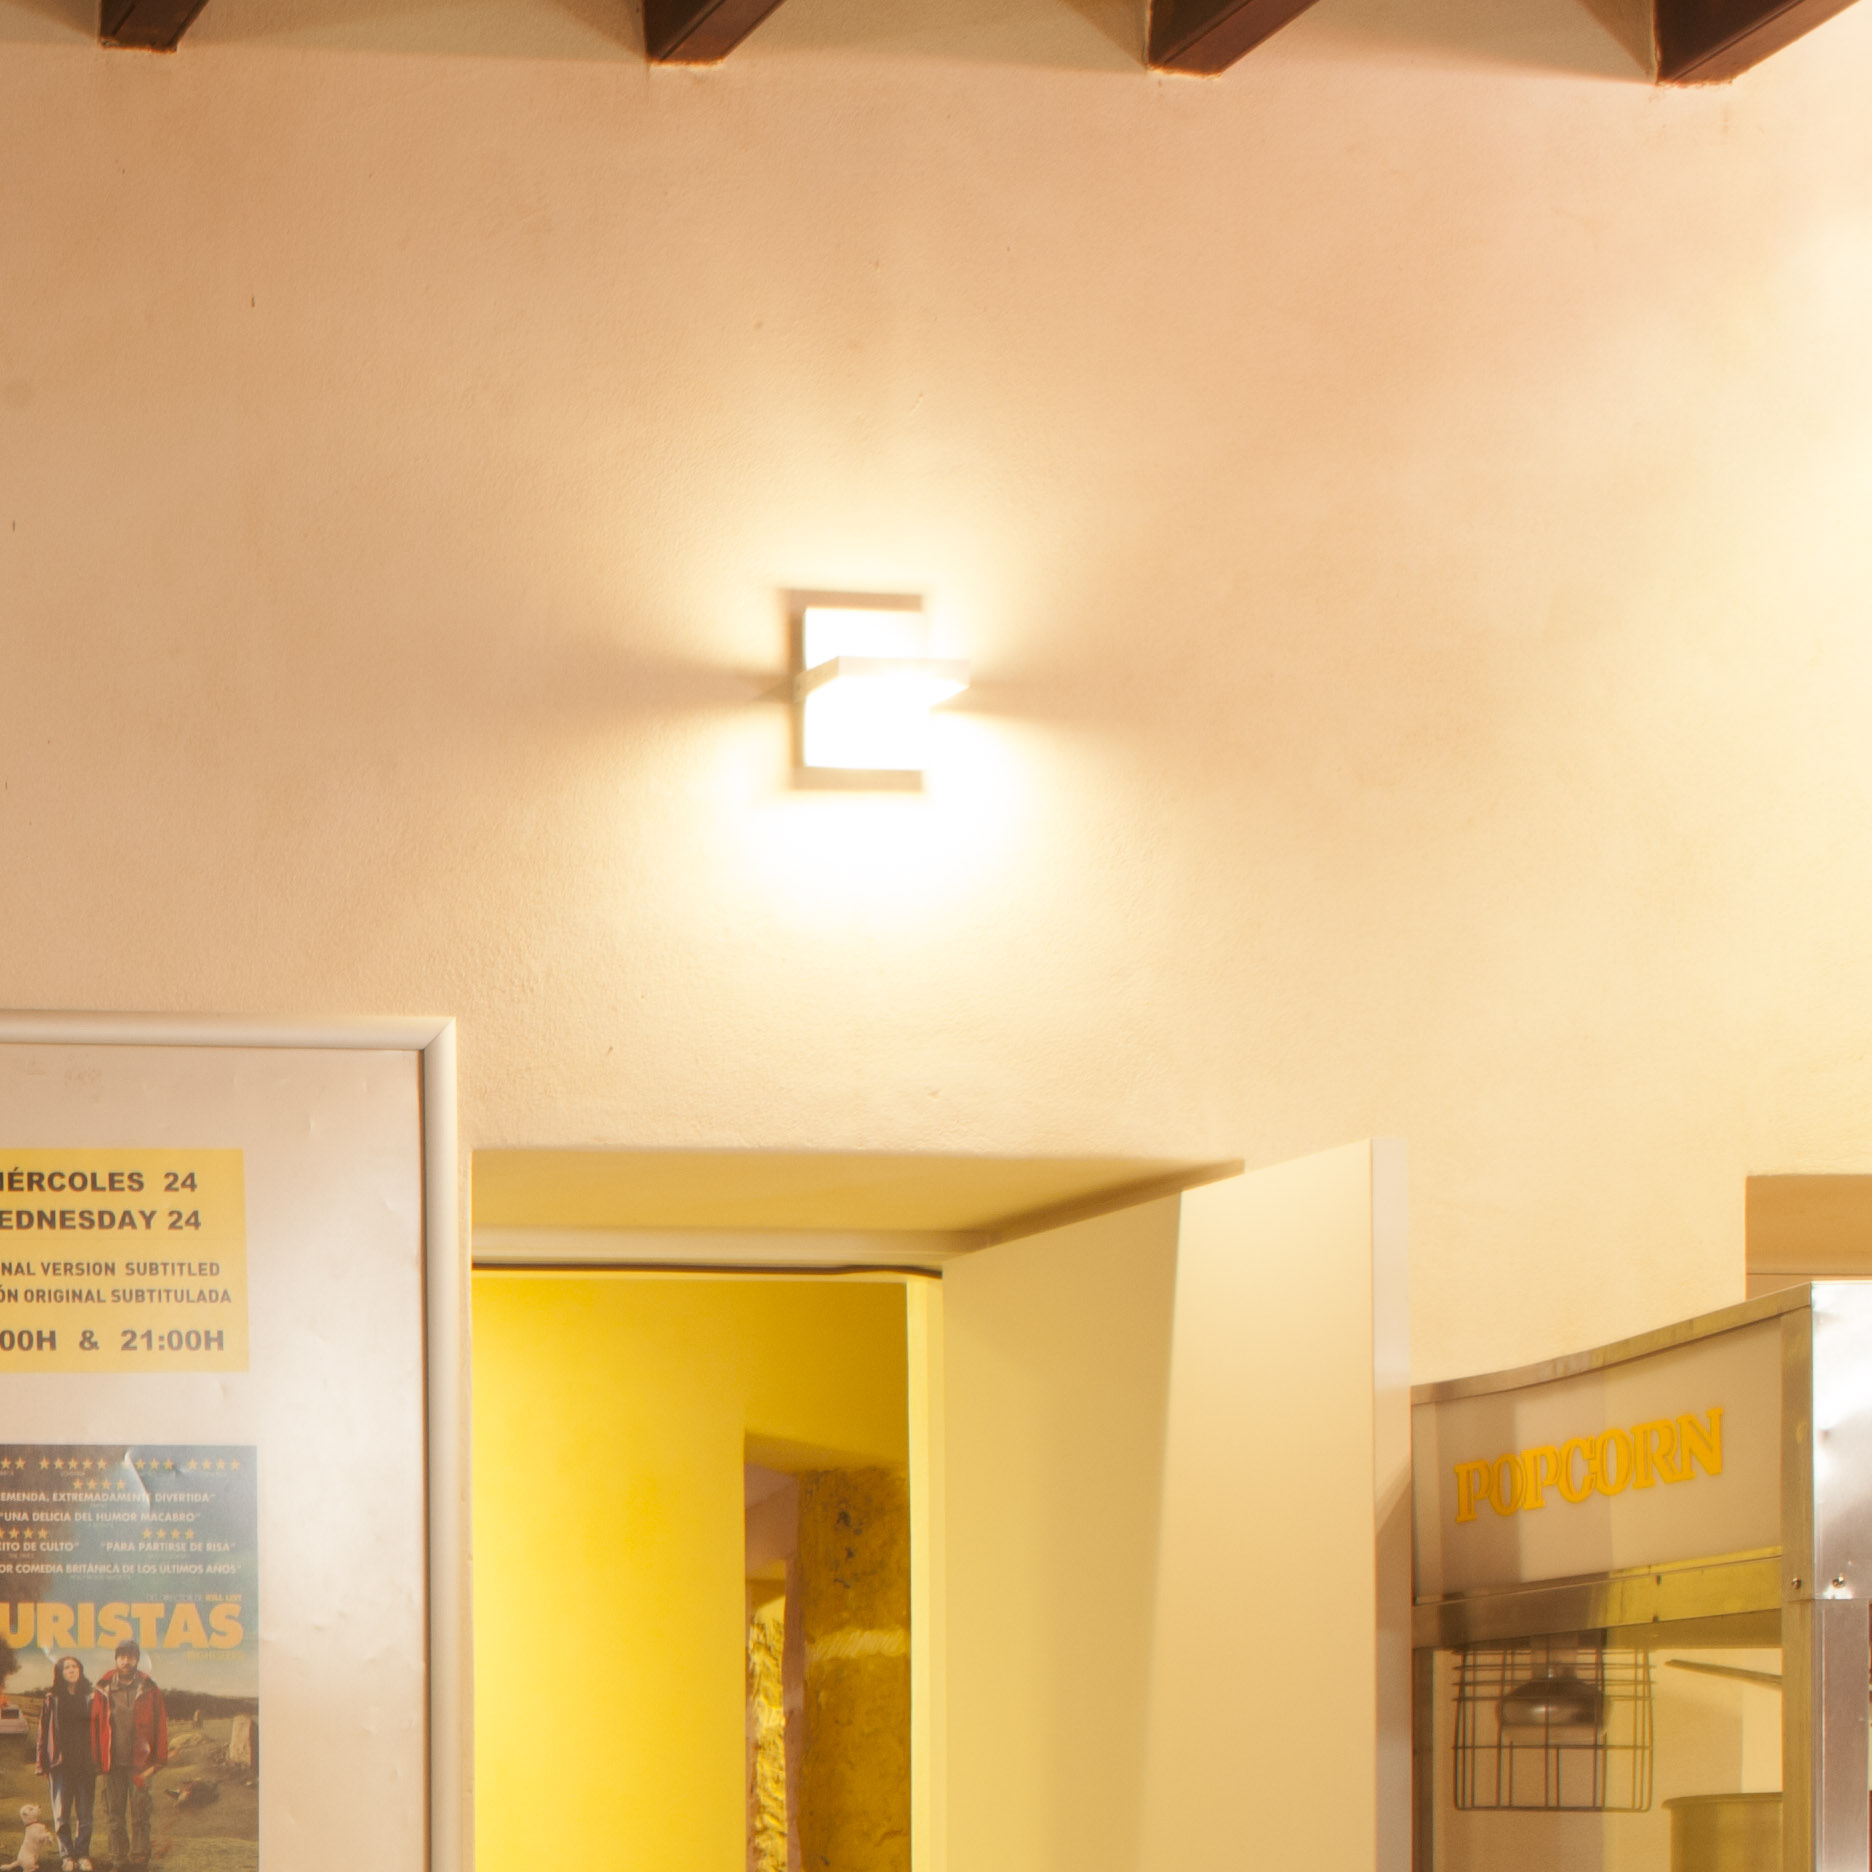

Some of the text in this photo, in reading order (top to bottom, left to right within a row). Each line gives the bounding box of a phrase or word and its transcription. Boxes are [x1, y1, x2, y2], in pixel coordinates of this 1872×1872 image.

[163, 1171, 197, 1192] 24
[167, 1210, 201, 1230] 24
[41, 1262, 116, 1276] VERSION
[125, 1262, 220, 1276] SUBTITLED
[24, 1289, 106, 1304] ORIGINAL
[111, 1289, 232, 1304] SUBTITULADA
[79, 1330, 100, 1351] &
[120, 1329, 224, 1351] 21:00H
[1454, 1406, 1724, 1524] POPCORN
[32, 1512, 71, 1522] DELICIA
[74, 1512, 93, 1522] DEL
[96, 1512, 137, 1522] HUMOR
[23, 1542, 38, 1552] DE
[190, 1542, 204, 1552] DE
[15, 1564, 64, 1574] COMEDIA
[122, 1564, 135, 1574] DE
[137, 1564, 157, 1574] LOS
